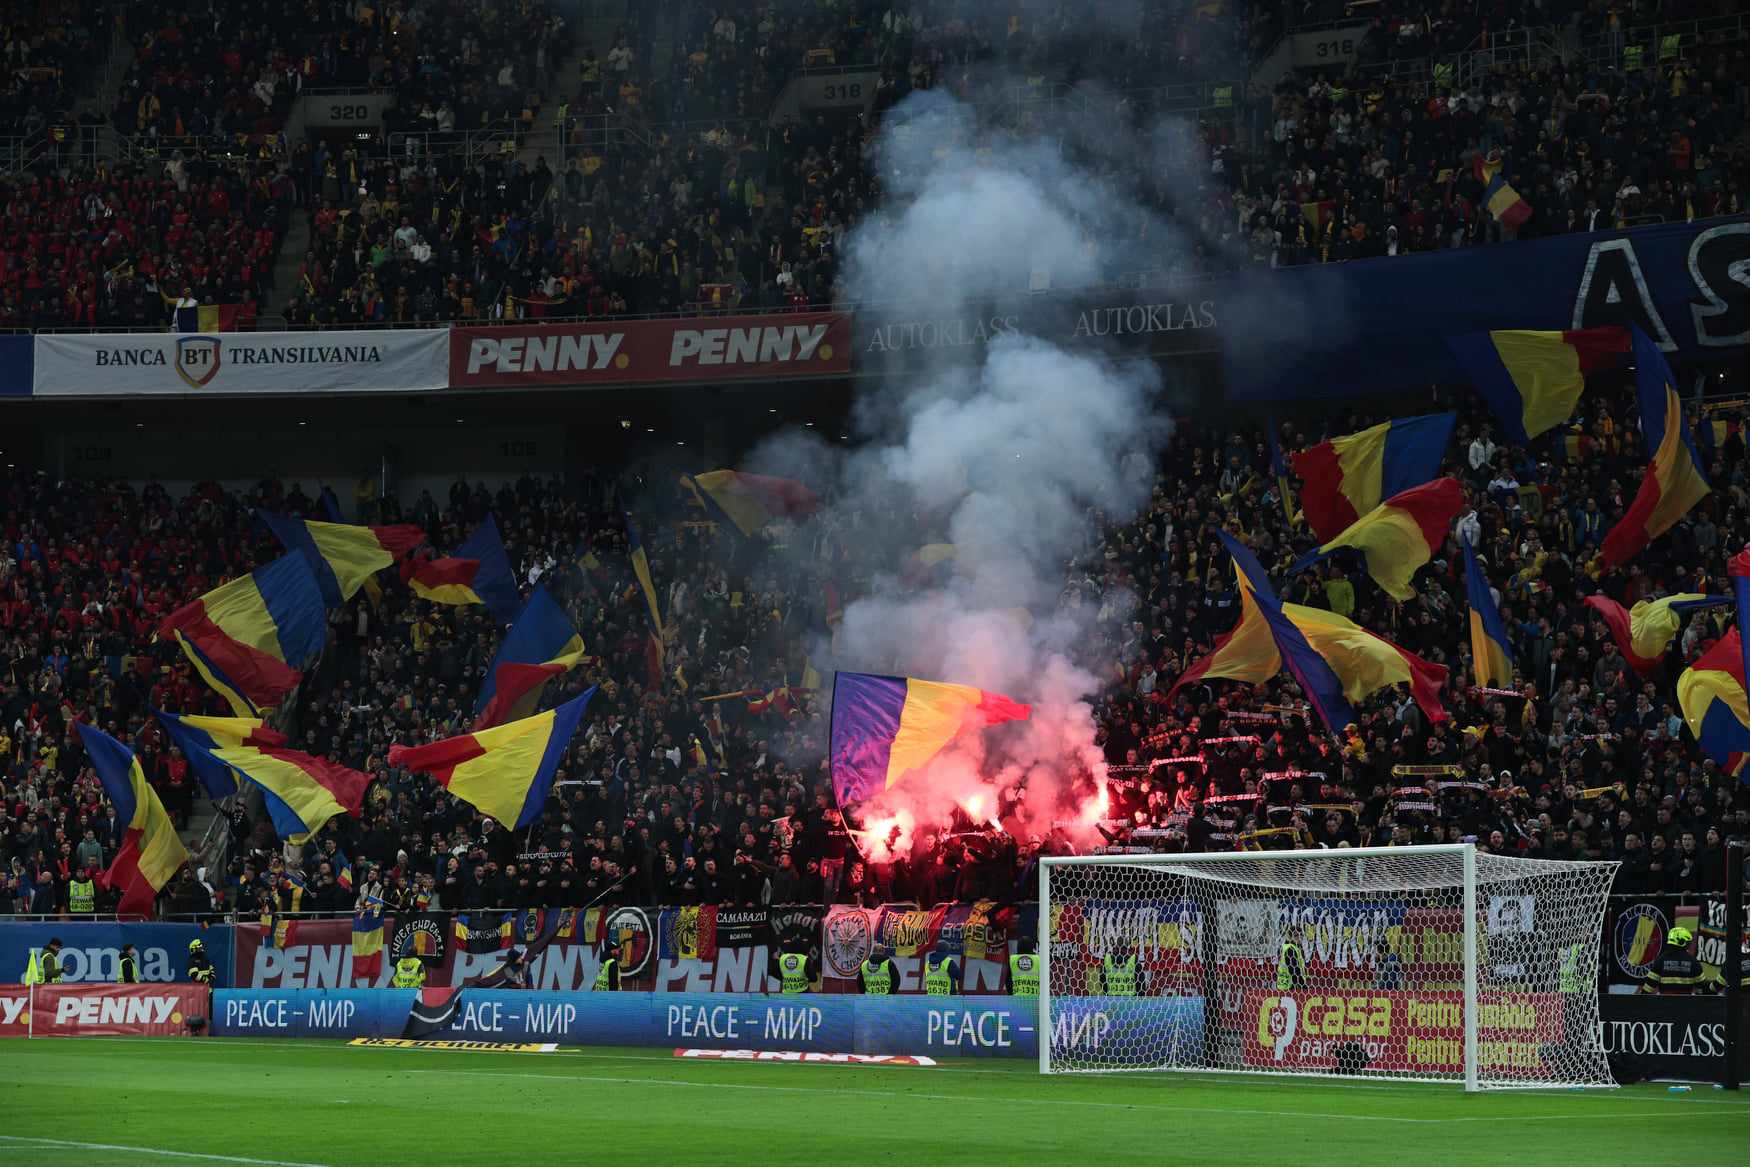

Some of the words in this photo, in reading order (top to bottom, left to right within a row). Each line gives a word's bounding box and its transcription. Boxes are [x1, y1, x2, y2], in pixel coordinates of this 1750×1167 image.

[823, 83, 862, 99] 318
[330, 105, 368, 120] 320
[867, 315, 1020, 351] AUTOKLASS
[1073, 301, 1216, 337] AUTOKLAS
[96, 349, 166, 366] BANCA
[185, 349, 212, 365] BT
[229, 346, 381, 365] TRANSILVANIA
[226, 1000, 288, 1027] PEACE
[308, 1000, 355, 1029] МИР
[452, 1002, 503, 1031] ACE
[525, 1003, 576, 1034] МИР
[667, 1005, 738, 1039] PEACE
[764, 1006, 822, 1041] МИР
[928, 1010, 1011, 1047] PEACE
[1302, 996, 1392, 1037] casa
[1407, 1001, 1461, 1029] Pentru
[1407, 1036, 1461, 1064] Pentru
[1587, 1020, 1726, 1057] AUTOKLASS
